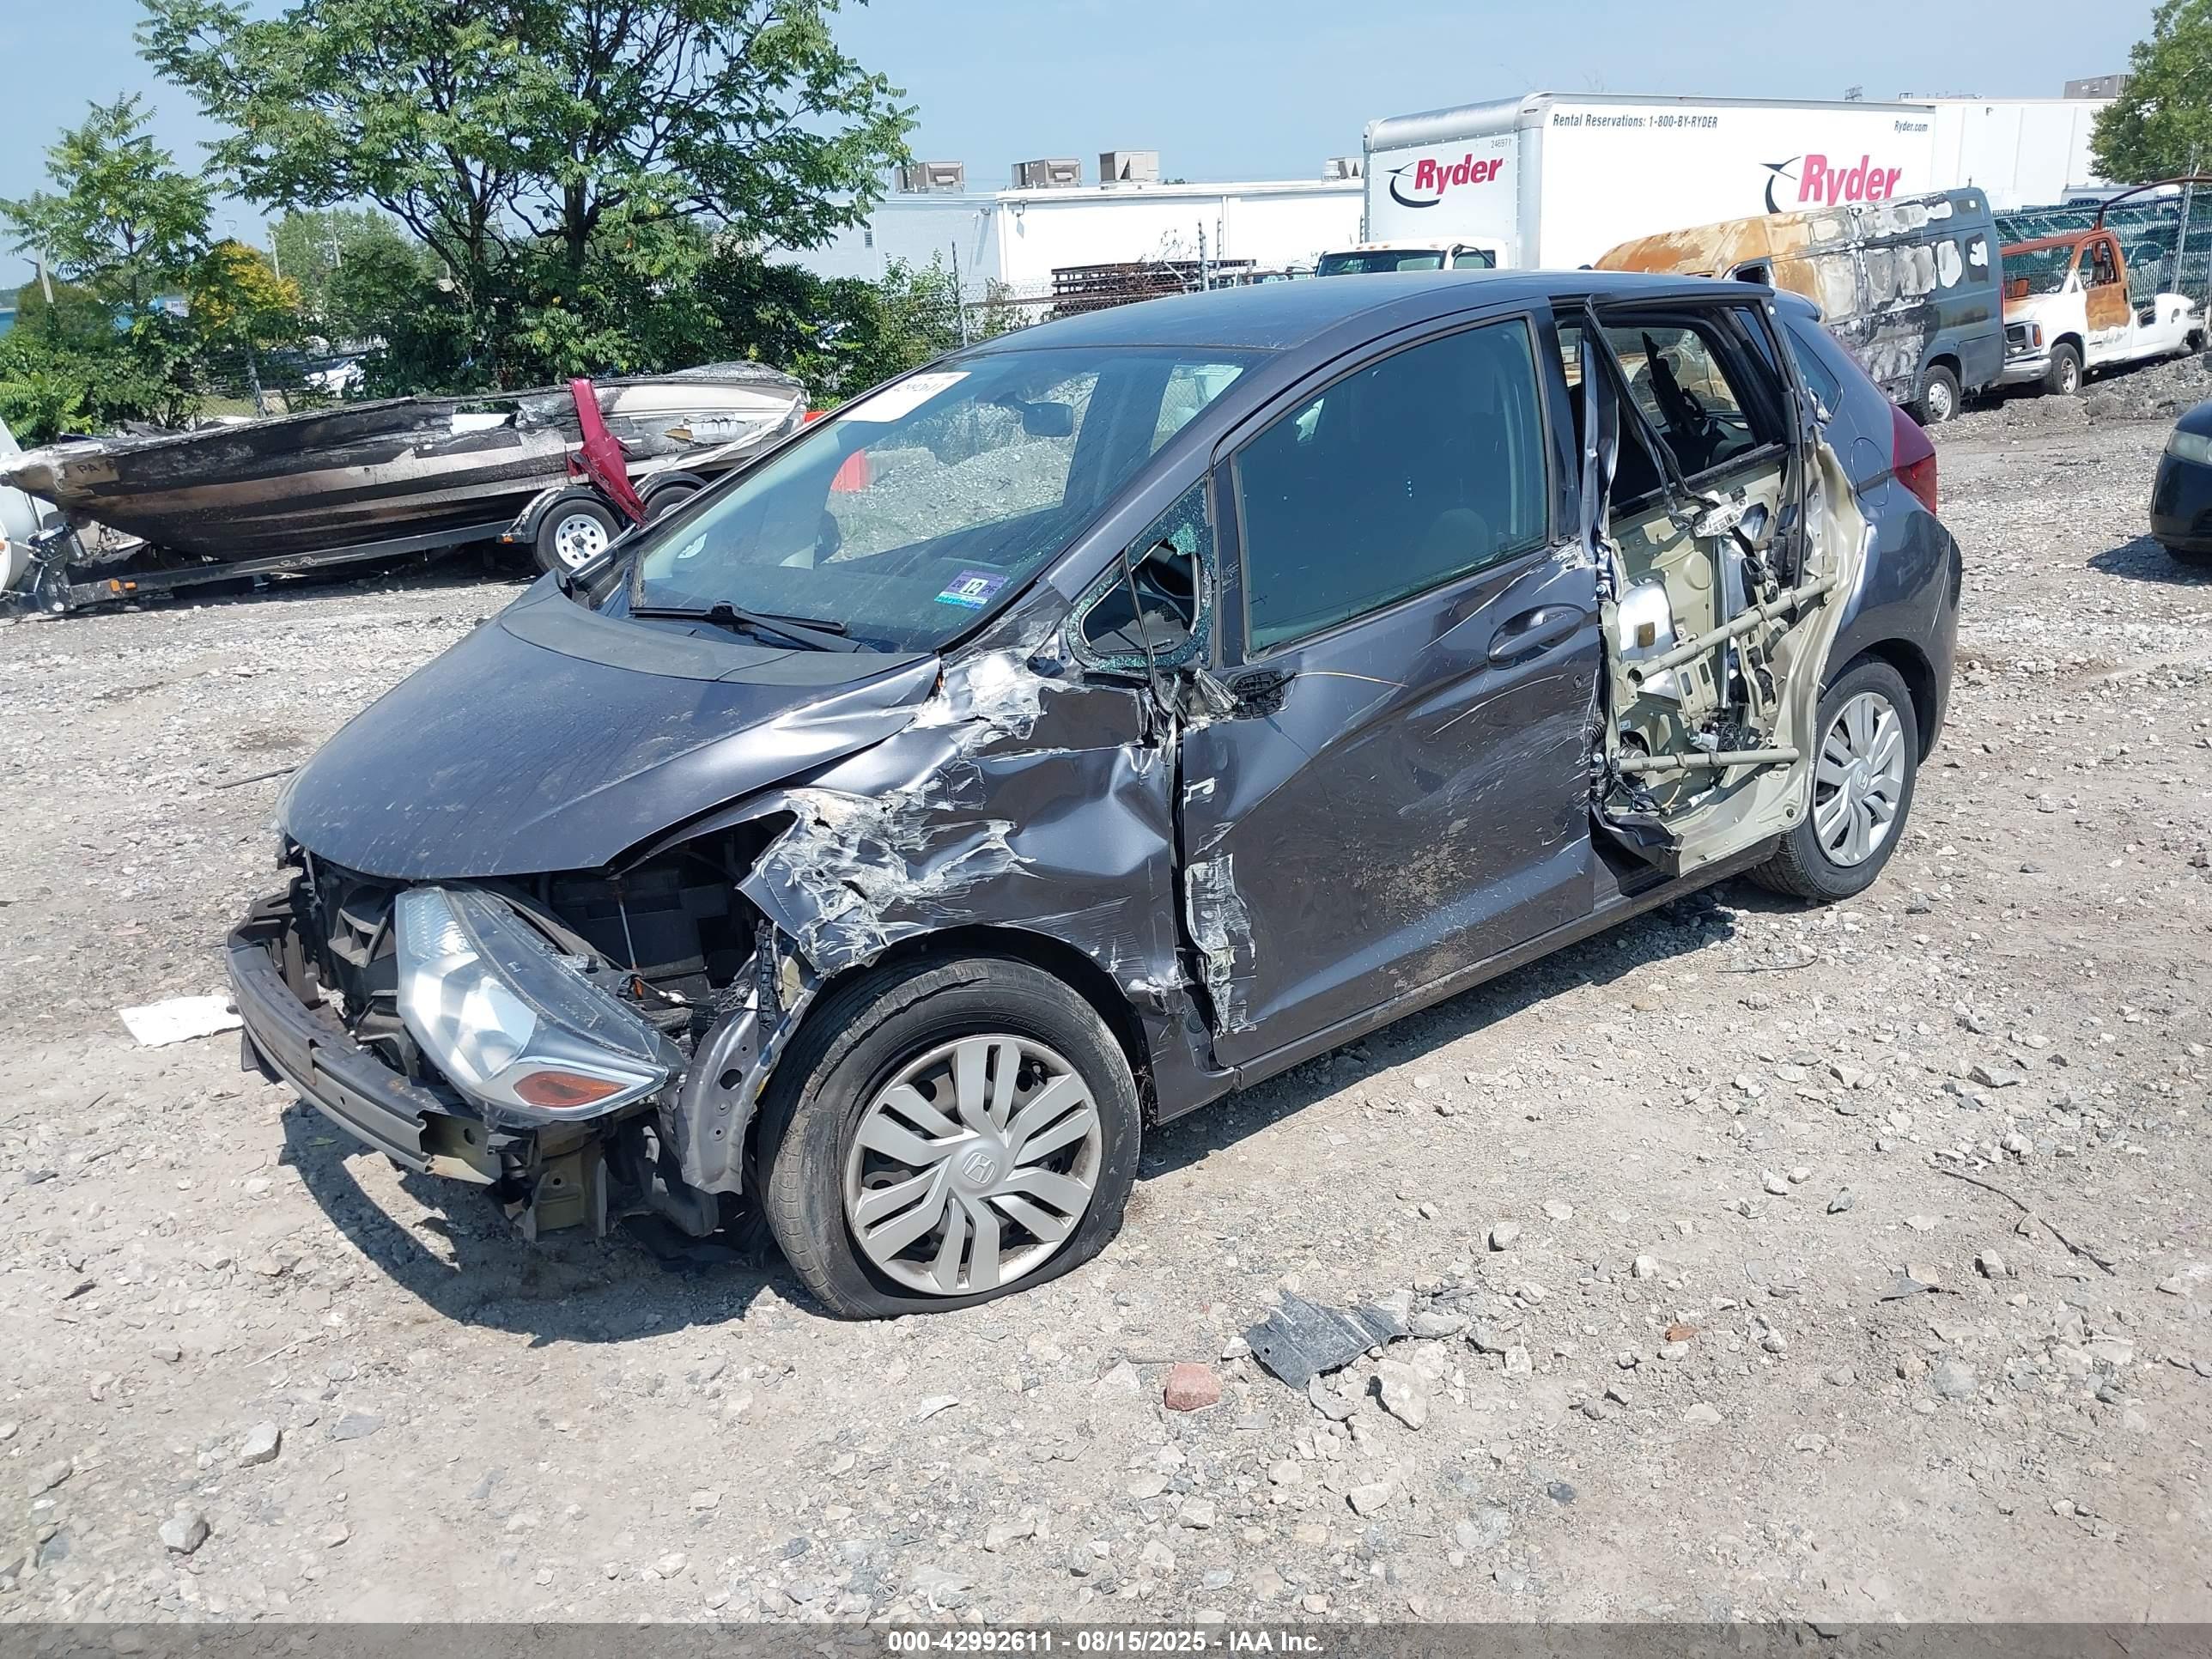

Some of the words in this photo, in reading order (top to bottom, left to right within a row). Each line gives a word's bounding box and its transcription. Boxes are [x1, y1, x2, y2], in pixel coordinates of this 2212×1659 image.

[1553, 113, 1583, 127] Rental
[1585, 113, 1647, 128] Reservations:
[1649, 115, 1718, 129] 1-800-BY-RYDER
[1893, 120, 1929, 133] Ryder.com
[1414, 153, 1504, 196] Ryder
[1797, 154, 1903, 207] Ryder
[963, 580, 983, 594] 12
